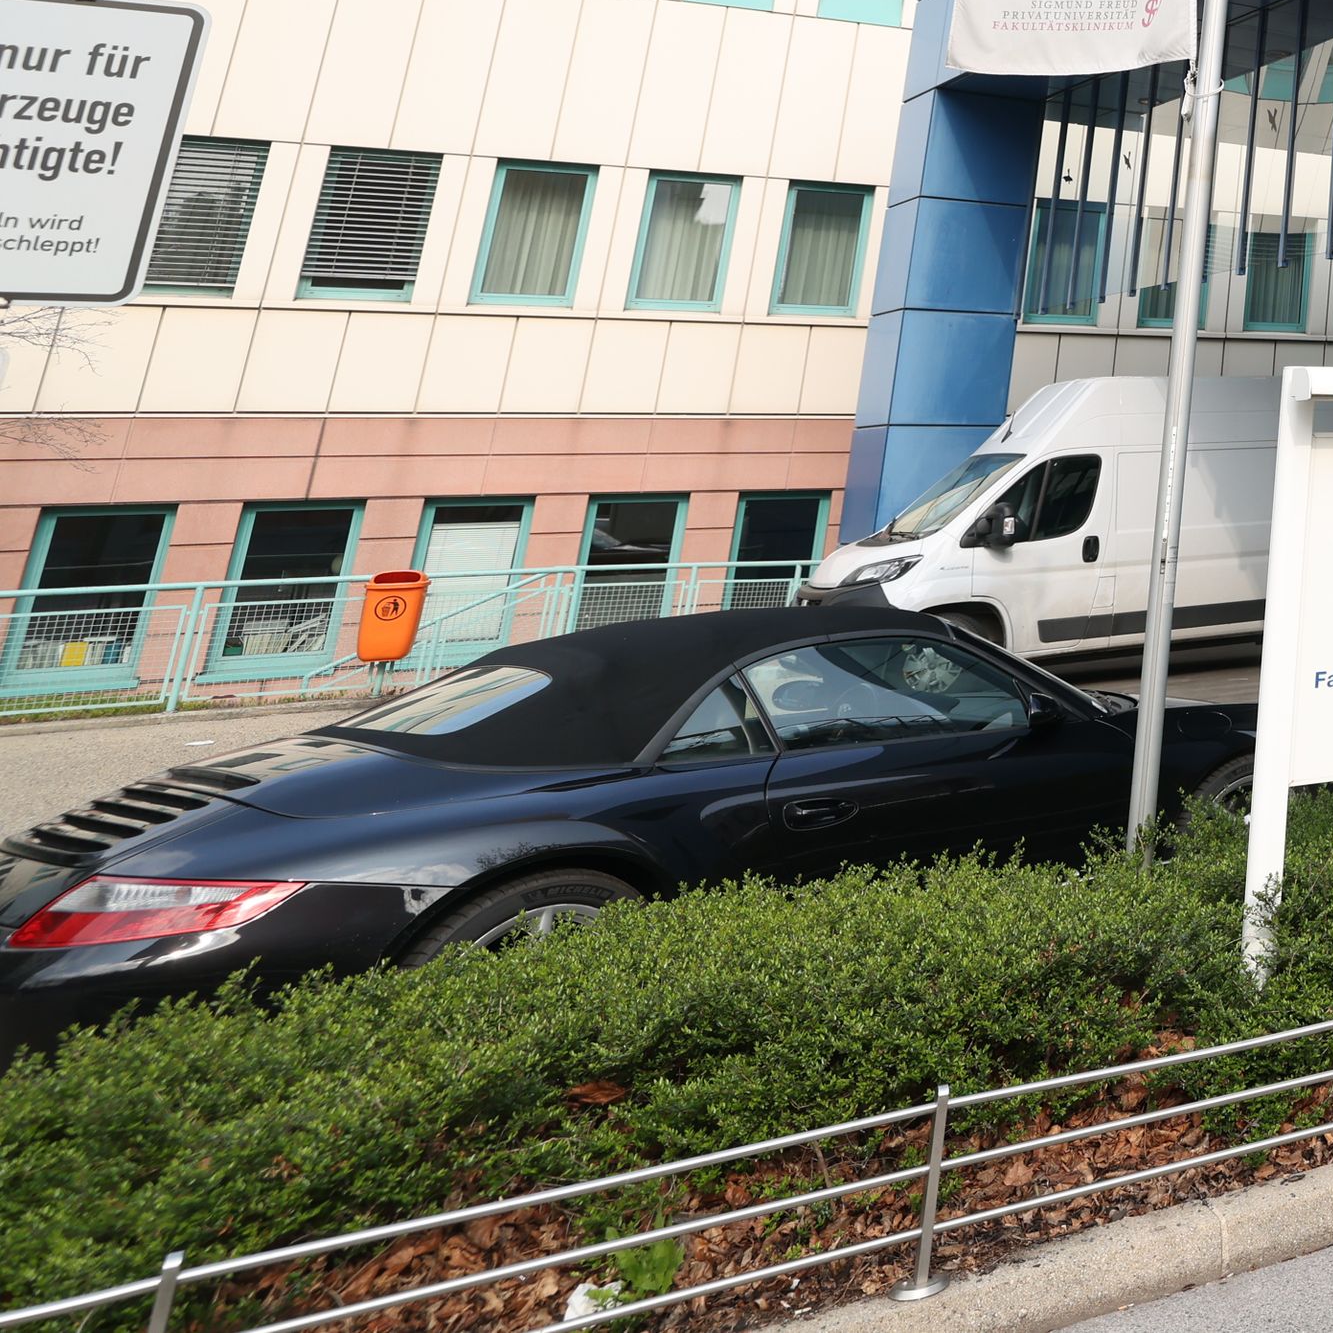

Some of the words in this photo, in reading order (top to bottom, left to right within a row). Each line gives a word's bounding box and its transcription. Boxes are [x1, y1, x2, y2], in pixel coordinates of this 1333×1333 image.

[1031, 0, 1093, 10] SIGMUND
[1099, 0, 1138, 9] FREUD
[1002, 9, 1137, 21] PRIVATUNIVERSITÄT
[992, 19, 1135, 32] FAKULTÄTSKLINIKUM
[0, 43, 71, 73] nur
[86, 42, 152, 80] für
[28, 214, 84, 232] wird
[0, 234, 100, 257] chleppt!
